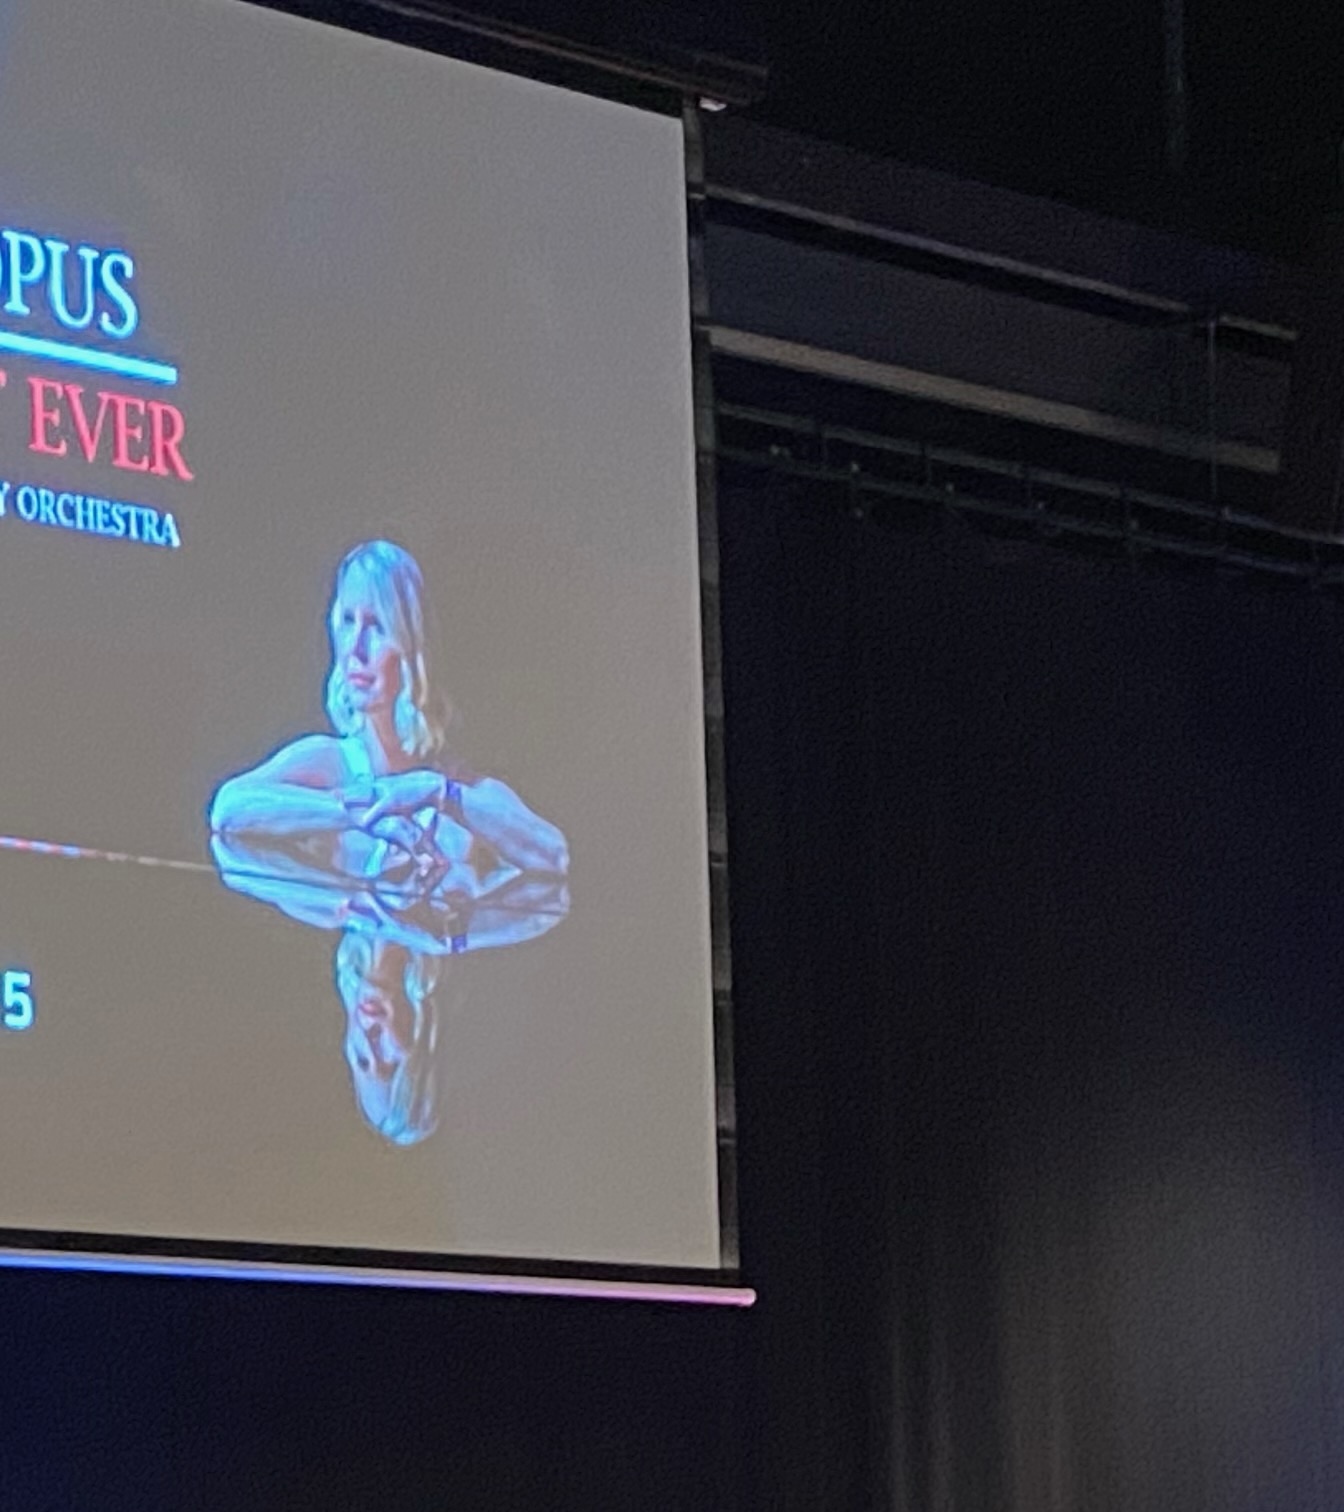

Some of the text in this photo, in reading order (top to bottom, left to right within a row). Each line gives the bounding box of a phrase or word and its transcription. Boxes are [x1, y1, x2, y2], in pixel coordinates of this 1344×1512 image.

[27, 376, 195, 481] EVER
[16, 483, 181, 548] ORCHESTRA
[2, 969, 35, 1030] 5
